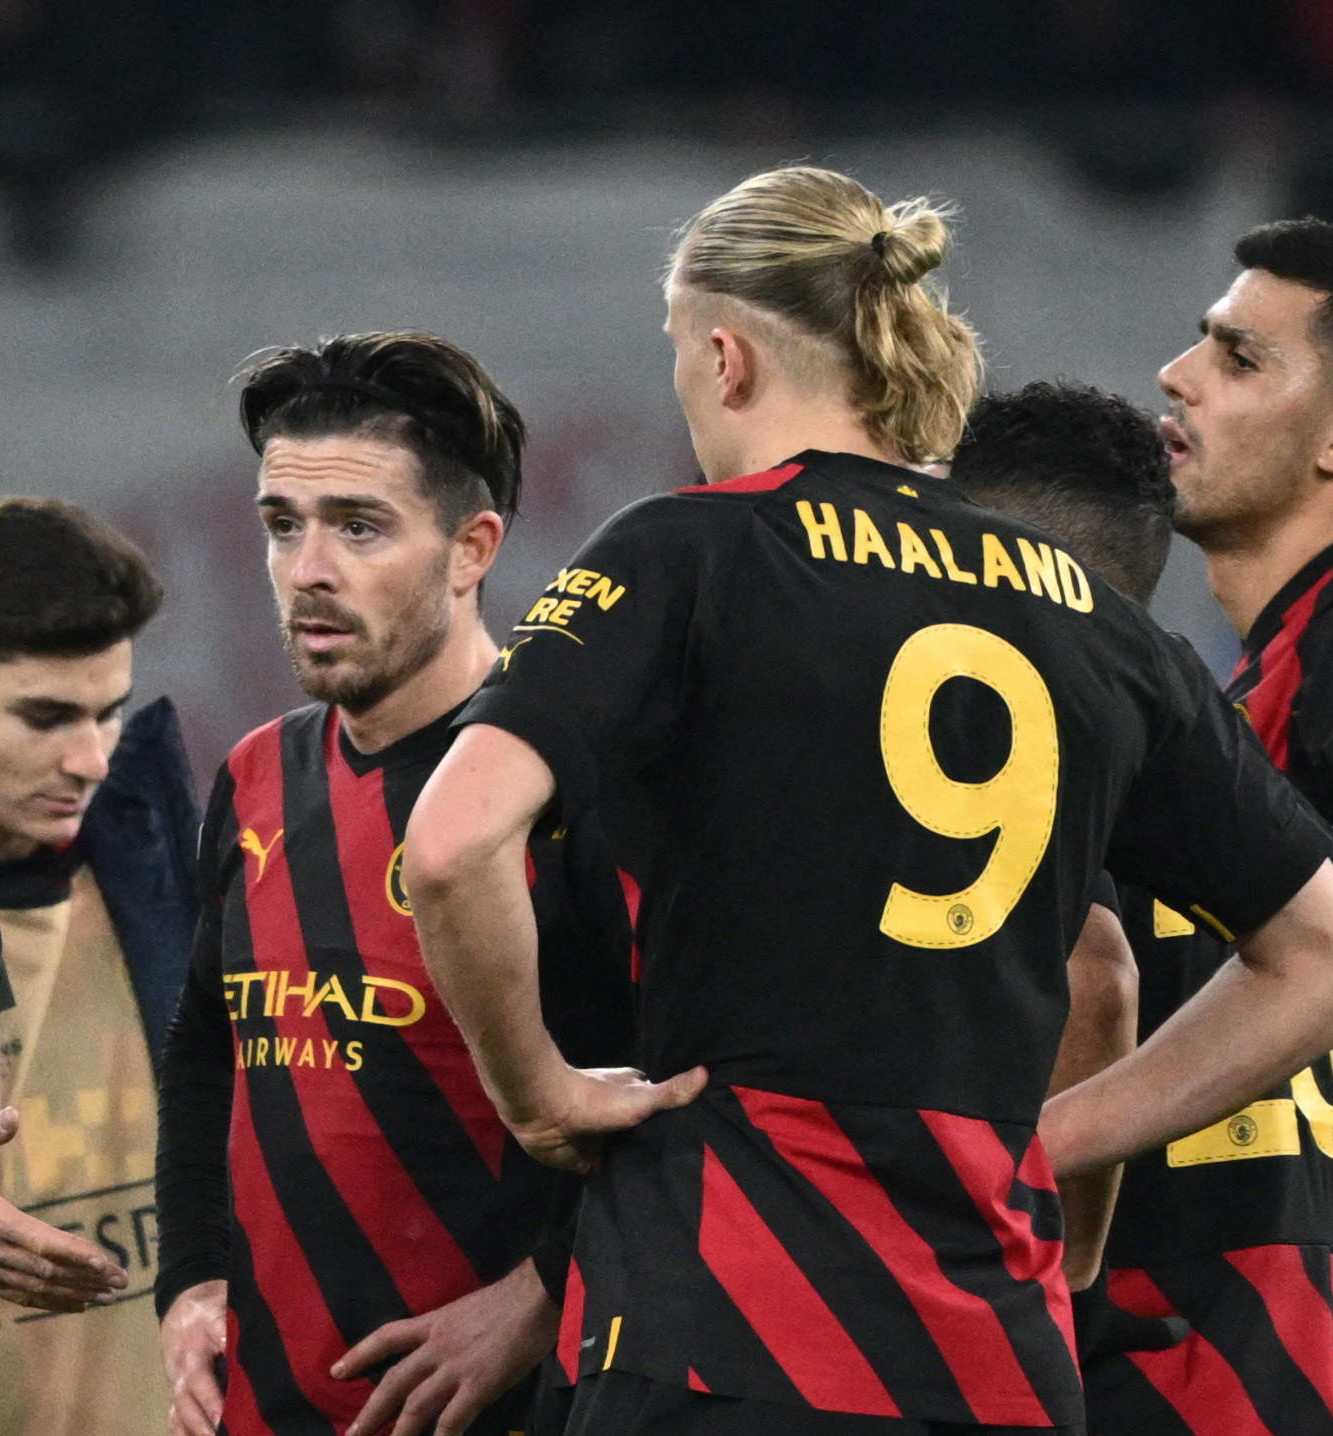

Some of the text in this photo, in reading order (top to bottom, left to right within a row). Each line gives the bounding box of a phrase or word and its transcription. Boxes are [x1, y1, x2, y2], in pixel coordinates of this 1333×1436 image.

[796, 500, 1094, 614] HAALAND
[525, 597, 582, 626] RE
[545, 568, 626, 611] XEN
[879, 622, 1060, 950] 9
[222, 970, 427, 1027] ETIHAD
